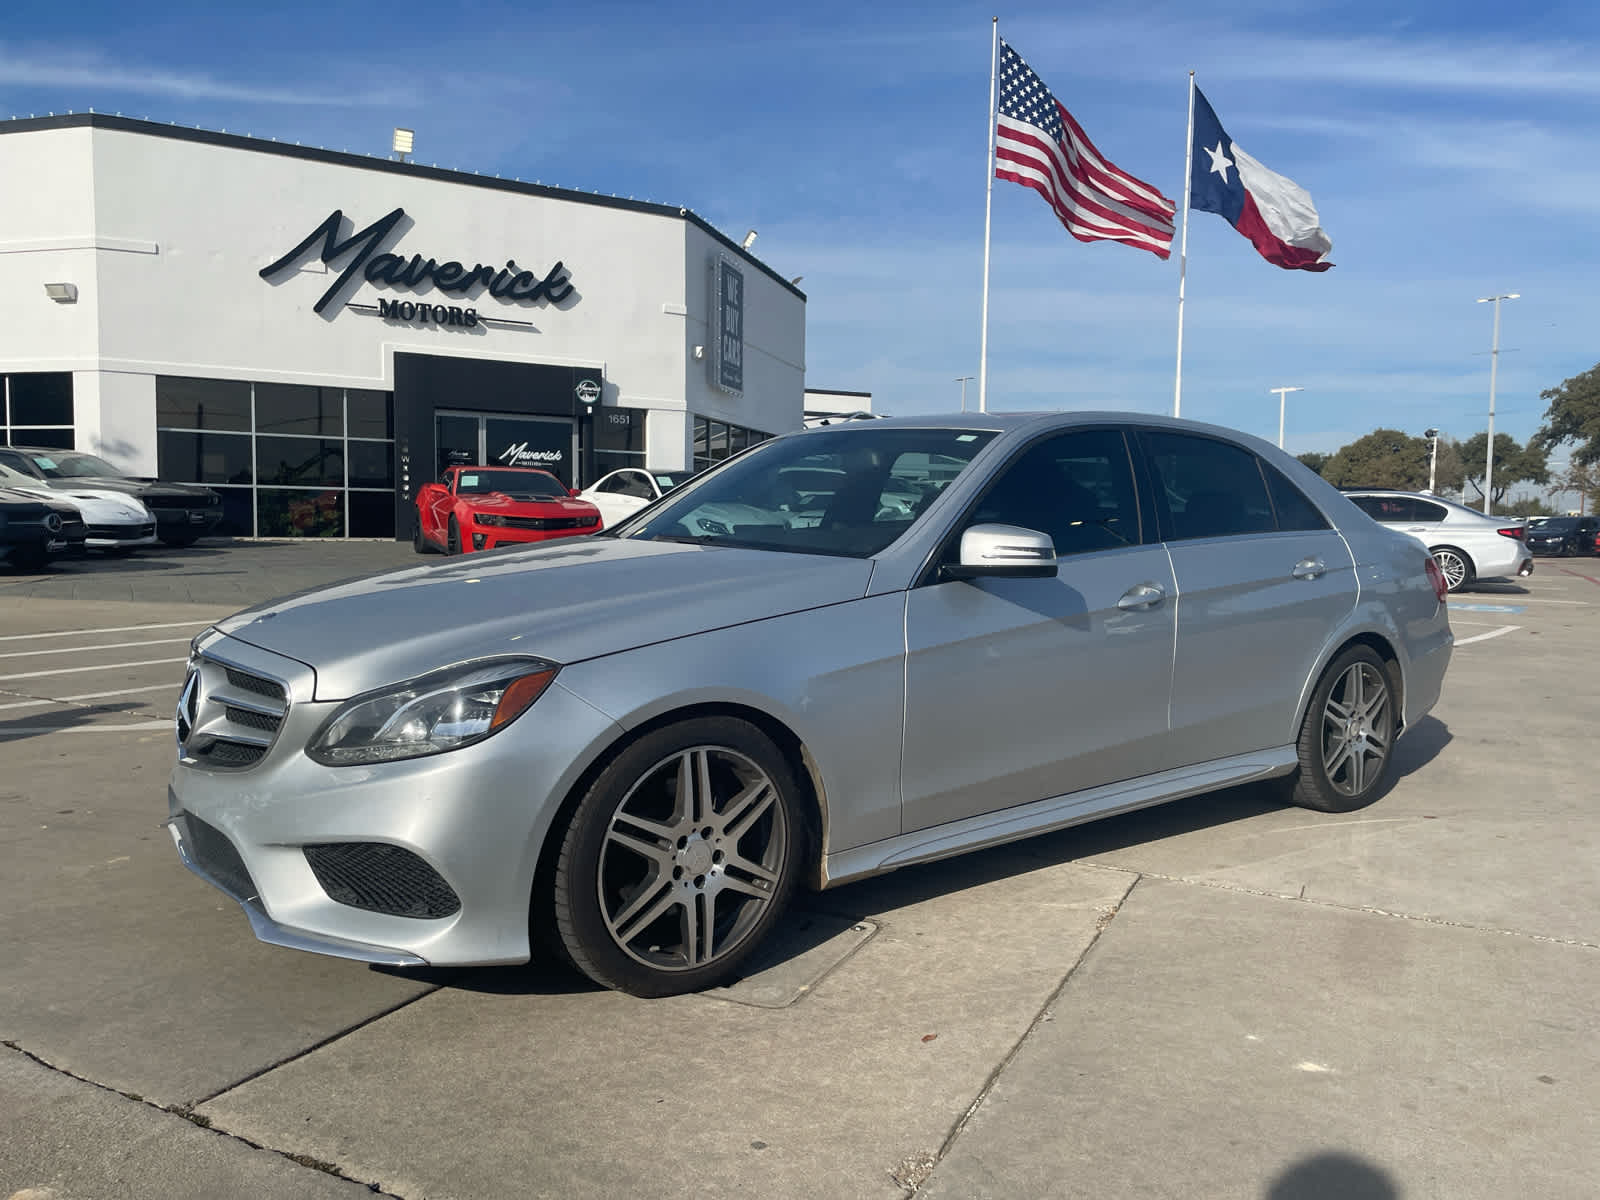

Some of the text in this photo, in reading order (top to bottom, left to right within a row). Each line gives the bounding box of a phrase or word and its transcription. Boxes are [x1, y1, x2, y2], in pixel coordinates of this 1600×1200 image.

[258, 207, 575, 316] Maverick
[377, 298, 479, 327] MOTORS
[726, 305, 740, 336] BUY
[608, 414, 630, 425] 1651
[498, 442, 562, 466] Maverick
